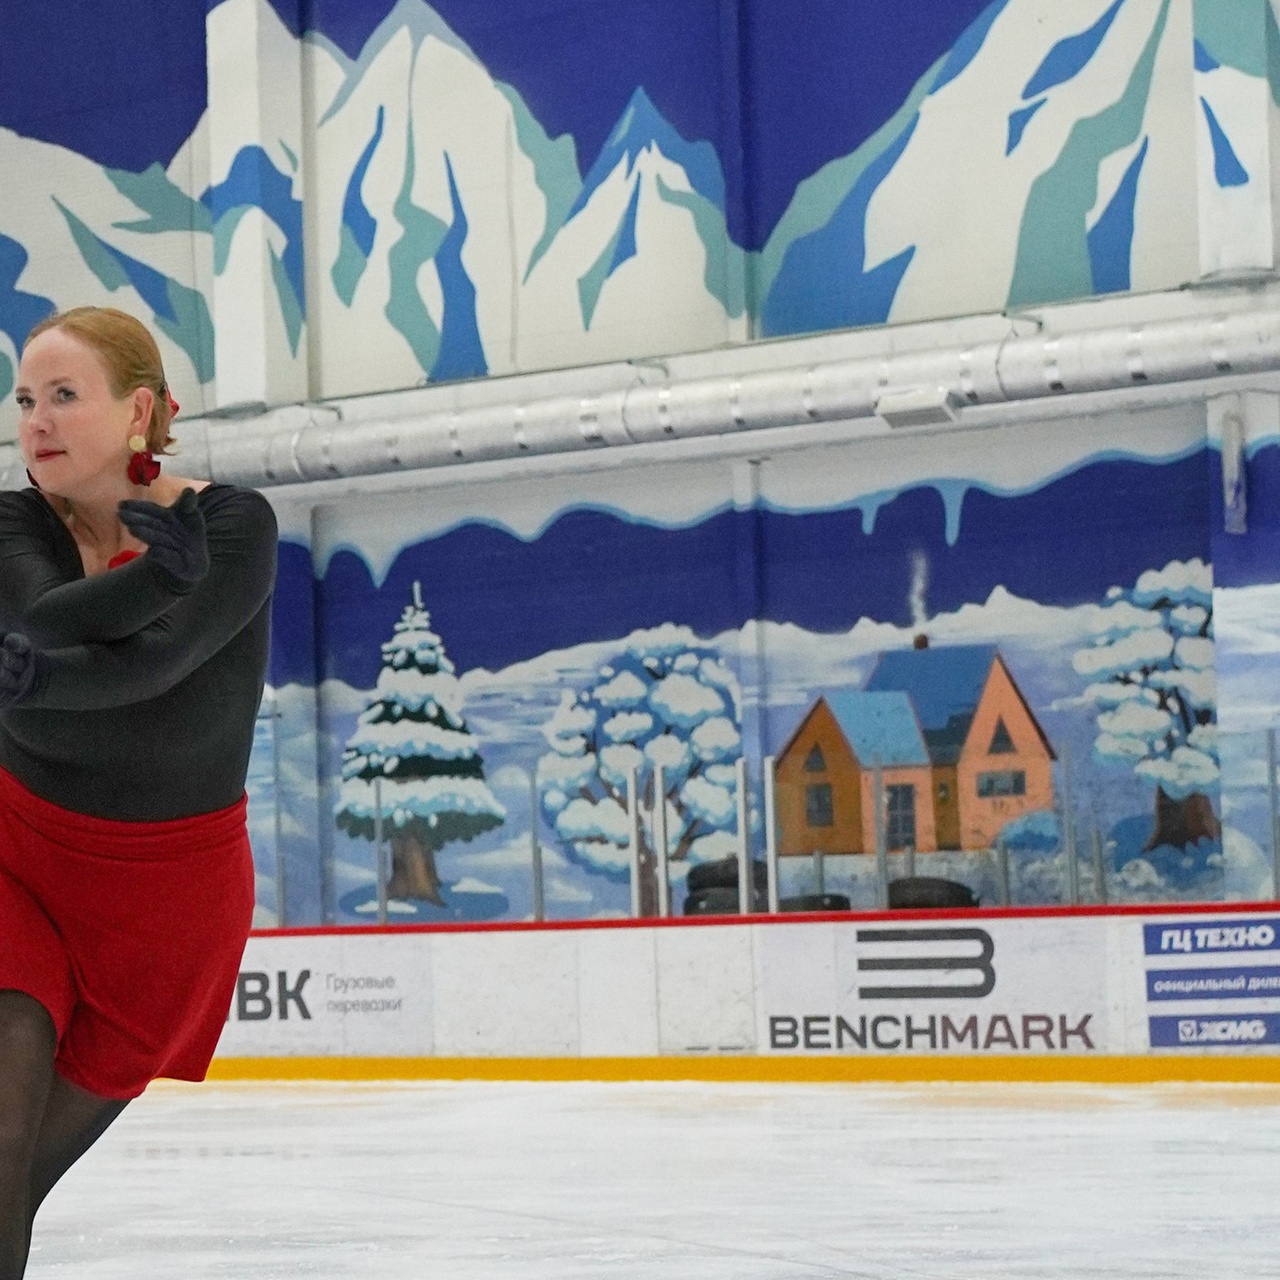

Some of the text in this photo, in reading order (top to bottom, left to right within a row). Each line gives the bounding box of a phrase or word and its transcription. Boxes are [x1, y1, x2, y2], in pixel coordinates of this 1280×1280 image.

[1161, 924, 1275, 952] ГЦ ТЕХНО
[226, 969, 313, 1022] ВК
[769, 1013, 1096, 1050] BENCHMARK
